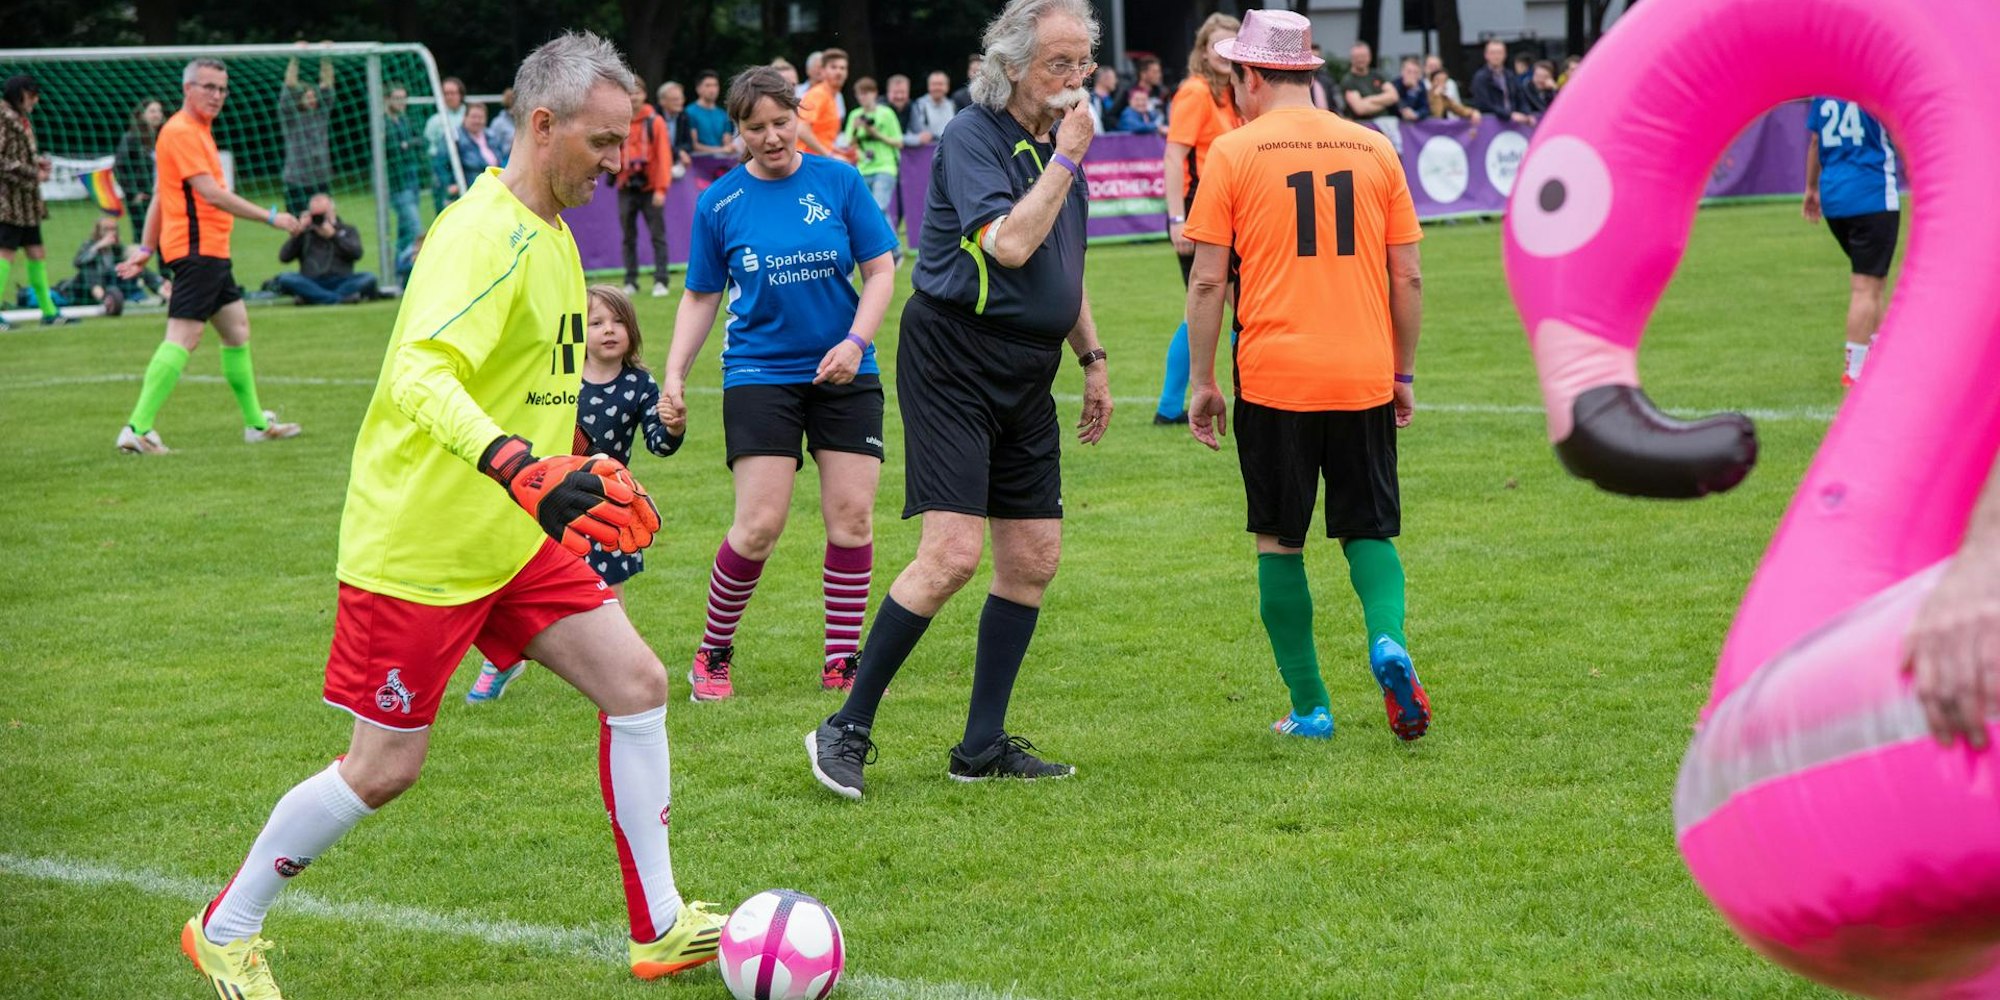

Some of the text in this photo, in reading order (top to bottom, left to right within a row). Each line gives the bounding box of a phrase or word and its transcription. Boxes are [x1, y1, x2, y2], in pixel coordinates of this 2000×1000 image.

[1820, 100, 1866, 147] 24
[1257, 141, 1374, 153] HOMOGENE BALLKULTUR
[713, 188, 744, 213] uhlsport
[1286, 170, 1355, 257] 11
[765, 250, 838, 269] Sparkasse
[768, 267, 835, 286] KölnBonn
[525, 391, 579, 406] NetColo
